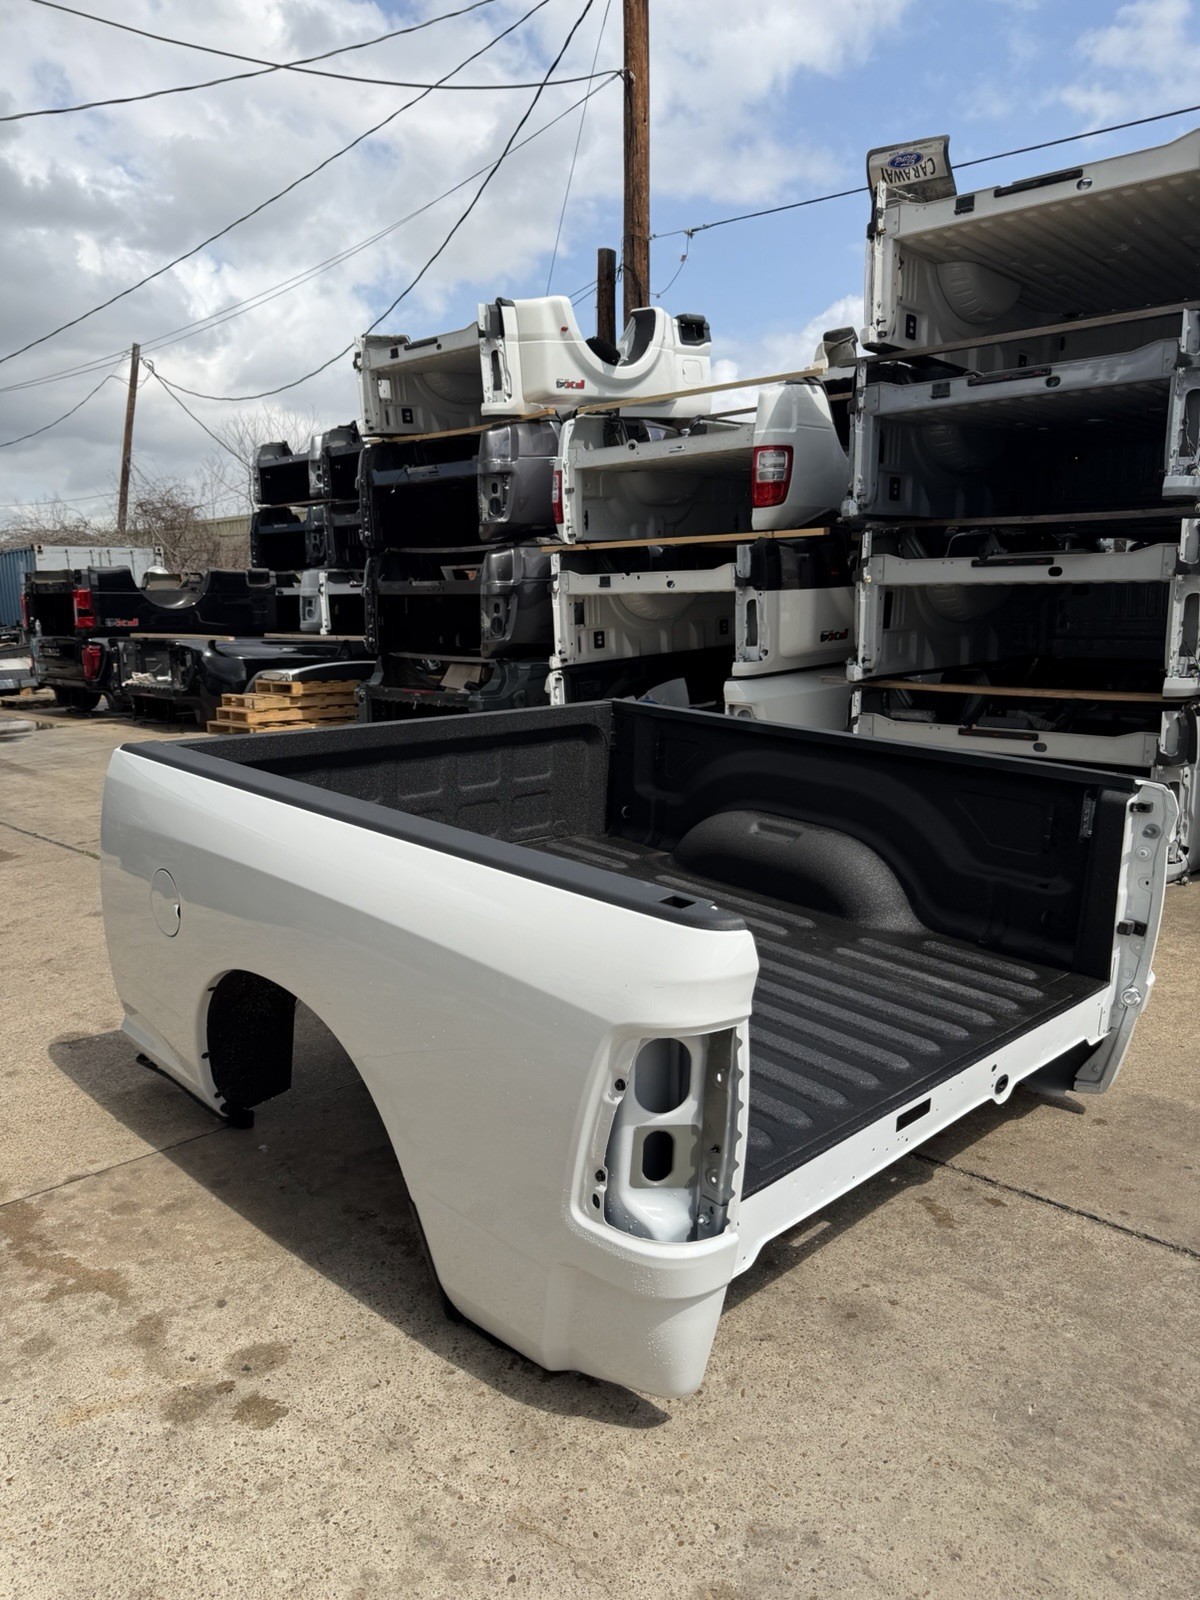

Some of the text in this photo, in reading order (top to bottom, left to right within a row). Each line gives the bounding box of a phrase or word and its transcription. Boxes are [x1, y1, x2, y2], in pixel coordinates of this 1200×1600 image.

[895, 154, 917, 167] Ford
[880, 157, 936, 185] CARAWAY
[556, 379, 585, 389] FX4
[820, 628, 849, 642] FX4
